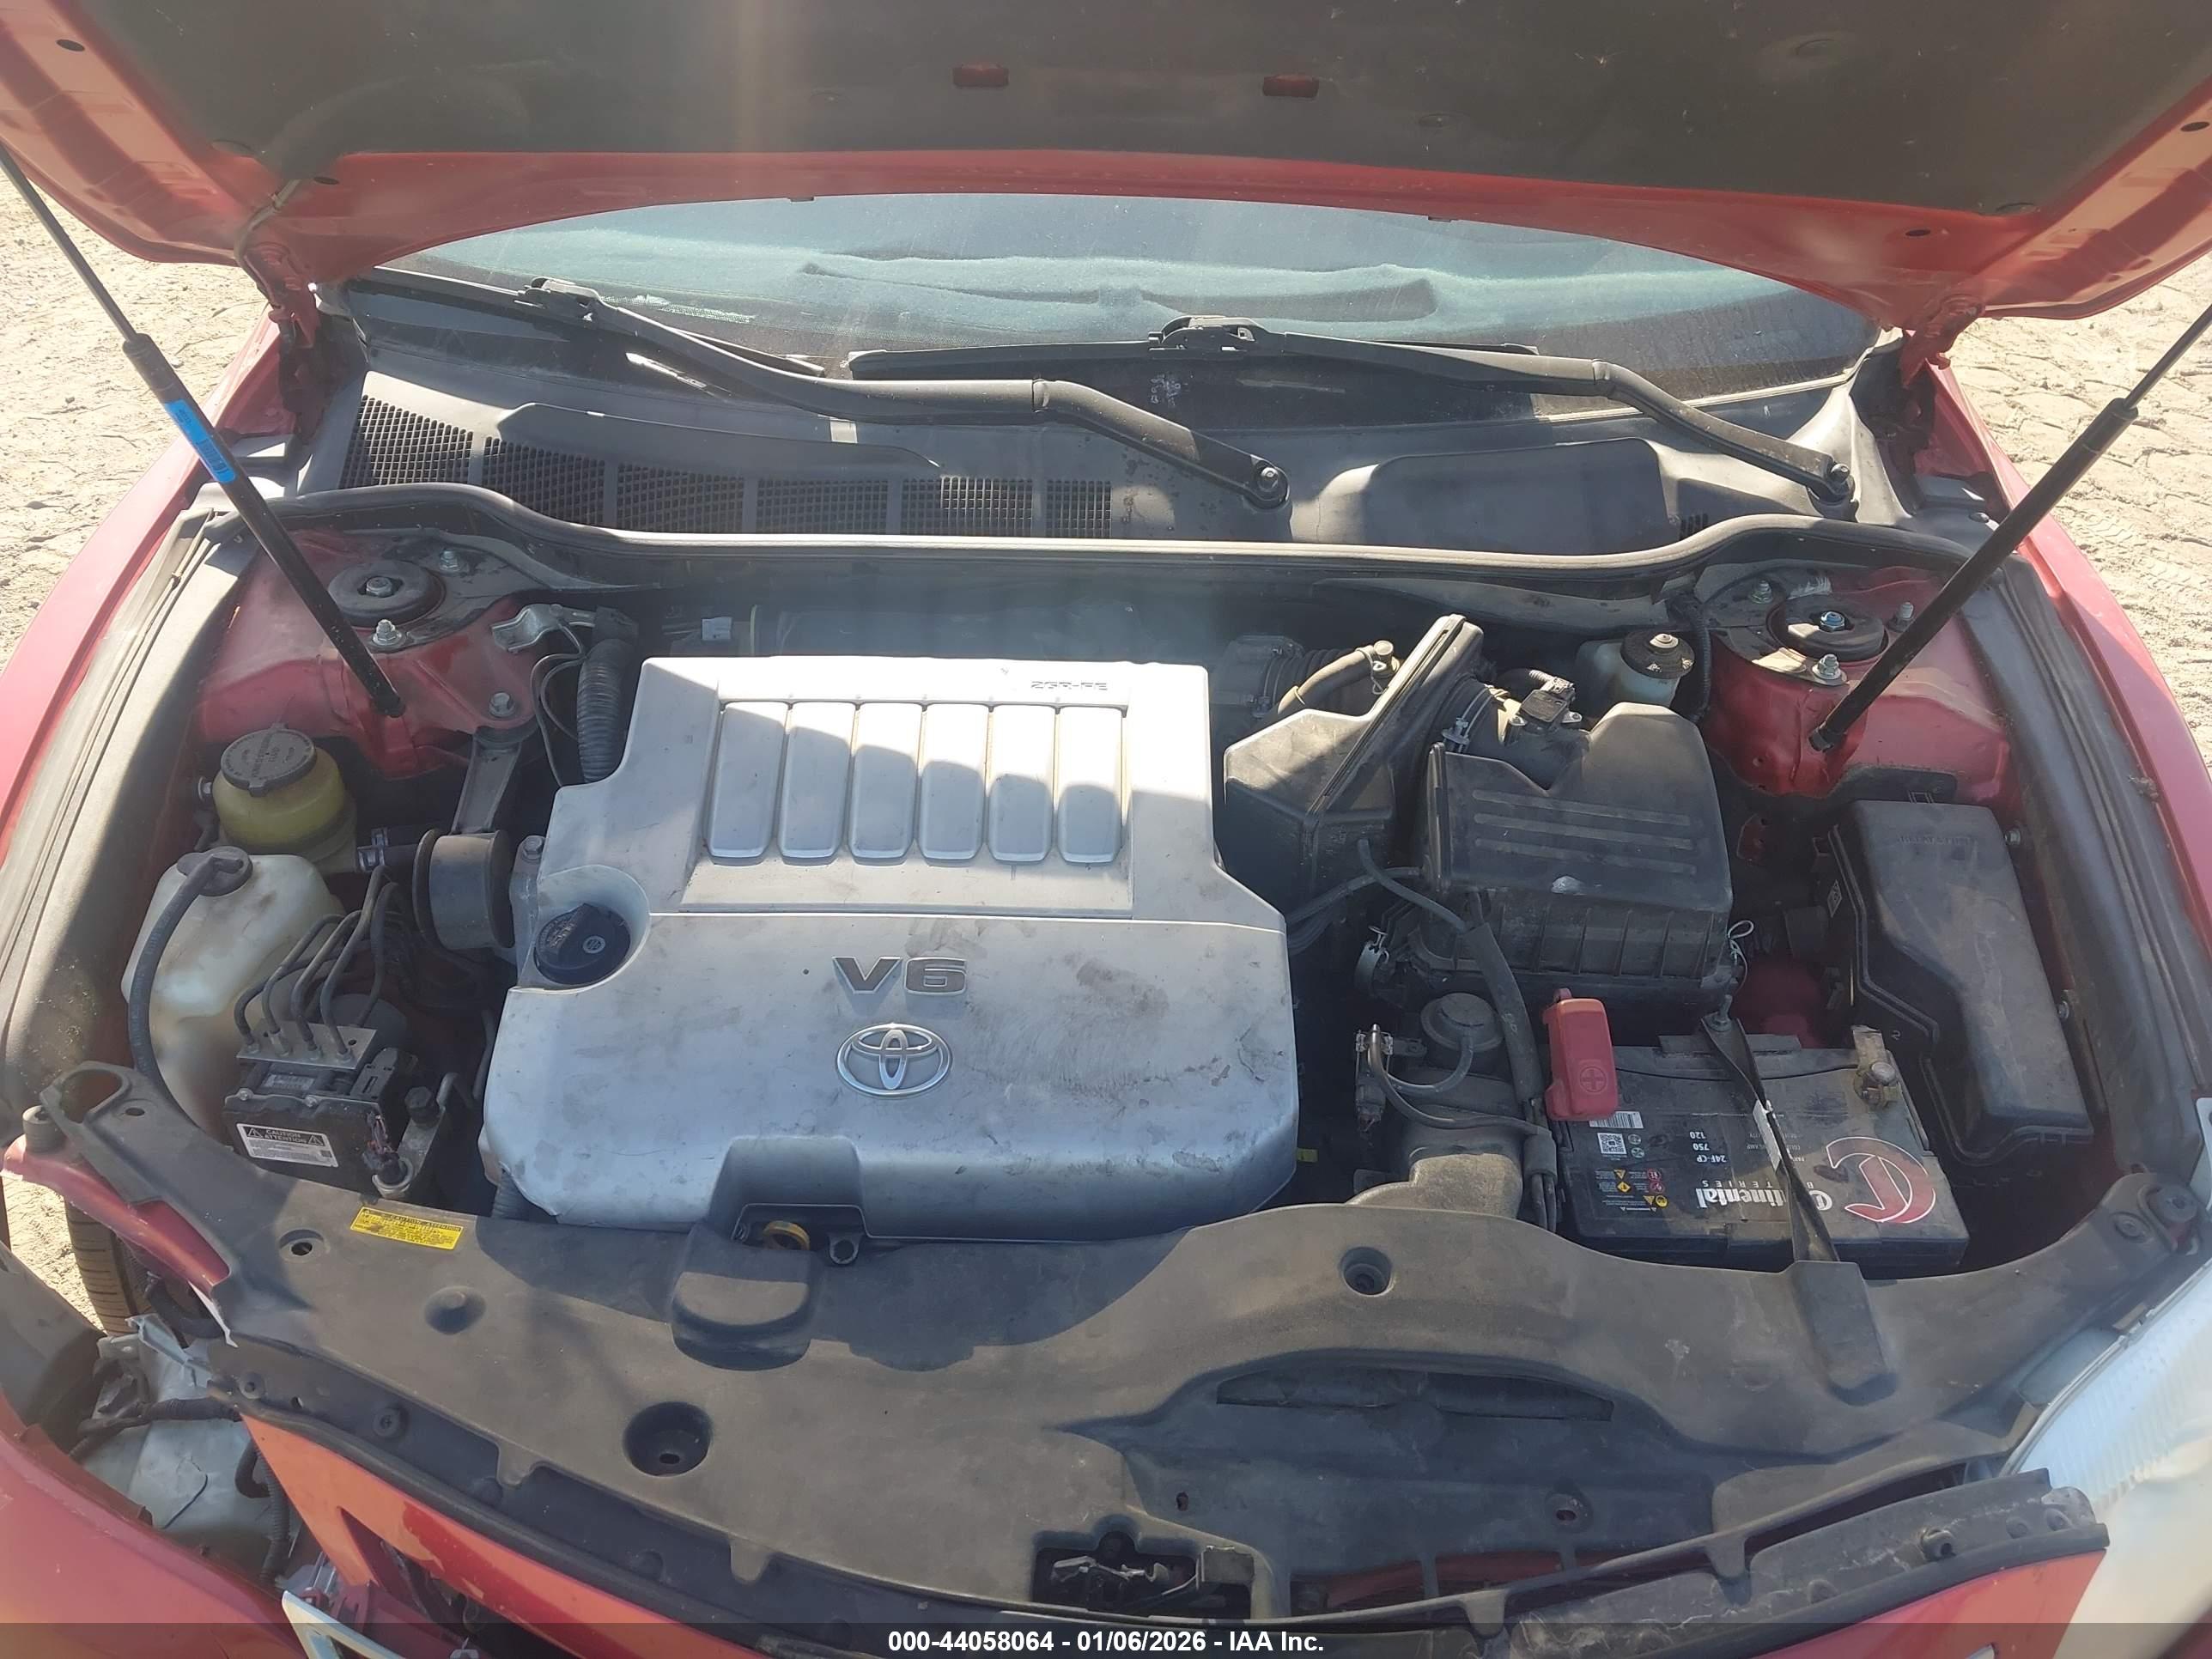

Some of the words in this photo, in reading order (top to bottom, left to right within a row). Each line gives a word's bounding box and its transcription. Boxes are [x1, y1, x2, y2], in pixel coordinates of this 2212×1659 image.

[832, 957, 967, 994] V6
[264, 1133, 307, 1144] ATTENTION
[265, 1129, 301, 1139] CAUTION
[1689, 1131, 1706, 1139] 120
[1696, 1154, 1727, 1163] 24F-CP
[1702, 1180, 1814, 1189] BTERIES
[1695, 1188, 1833, 1211] Ctinental
